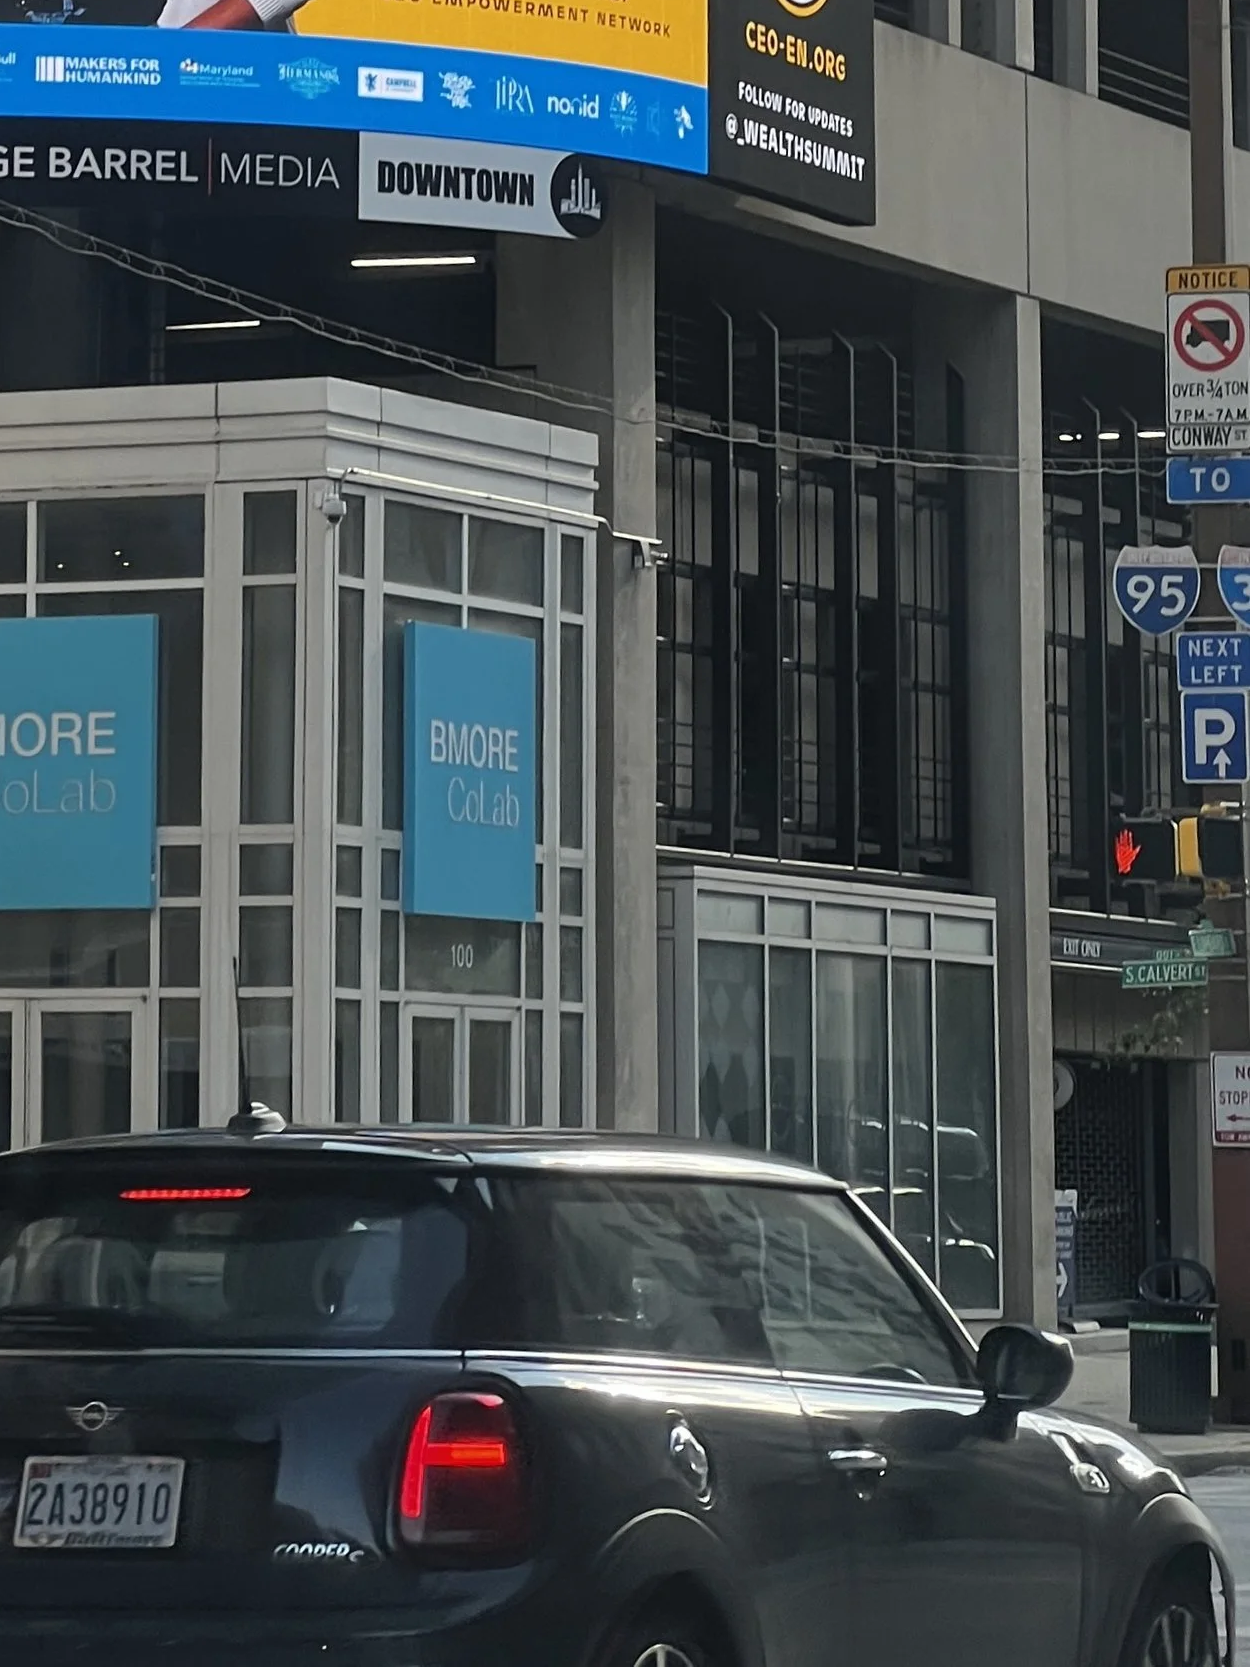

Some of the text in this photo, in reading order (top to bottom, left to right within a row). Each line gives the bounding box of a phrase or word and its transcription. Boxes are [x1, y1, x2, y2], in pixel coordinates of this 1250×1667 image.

[596, 10, 672, 39] NETWORK
[65, 56, 159, 72] MAKERS FOR
[745, 21, 846, 81] CEO-EN.ORG
[65, 70, 161, 85] HUMANKIND
[200, 63, 254, 77] Maryland
[738, 81, 853, 137] FOLLOW FOR UPDATES
[725, 113, 866, 181] @_WEALTHSUMMIT
[48, 146, 199, 183] BARREL
[218, 151, 342, 192] MEDIA
[377, 159, 536, 209] DOWNTOWN
[1178, 271, 1238, 289] NOTICE
[1172, 383, 1205, 398] OVER
[1224, 380, 1249, 396] TON
[1172, 425, 1232, 447] CONWAY
[1190, 467, 1231, 493] TO
[1126, 574, 1186, 617] 95
[1188, 638, 1242, 657] NEXT
[1191, 665, 1242, 684] LEFT
[429, 719, 519, 773] BMORE
[1194, 708, 1235, 765] P
[447, 776, 520, 828] CoLab
[450, 944, 473, 969] 100
[1063, 937, 1100, 958] EXIT ONLY
[27, 1483, 171, 1526] 2A38910
